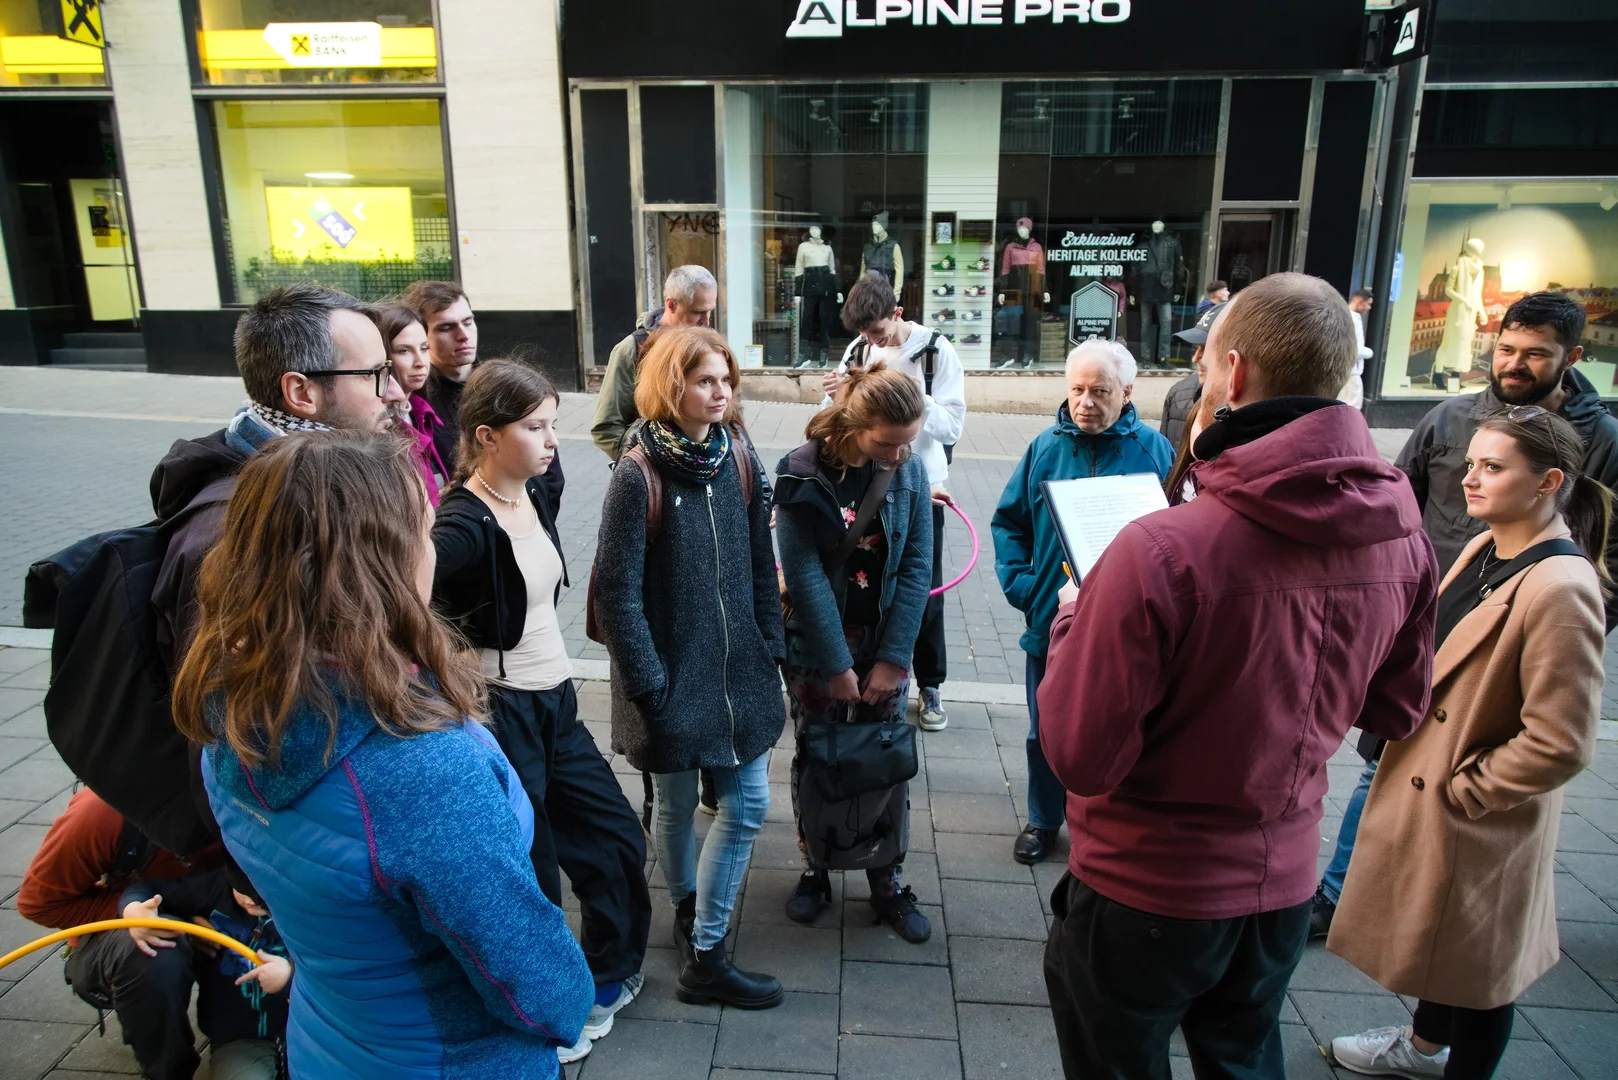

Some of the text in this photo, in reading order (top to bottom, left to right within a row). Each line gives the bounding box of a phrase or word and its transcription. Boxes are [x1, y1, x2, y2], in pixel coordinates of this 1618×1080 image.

[786, 0, 1132, 37] ALPINE PRO
[316, 46, 347, 56] BANK
[1061, 231, 1135, 247] Exkluzivní
[1047, 249, 1148, 261] HERITAGE KOLEKCE
[1070, 265, 1123, 276] ALPINE PRO
